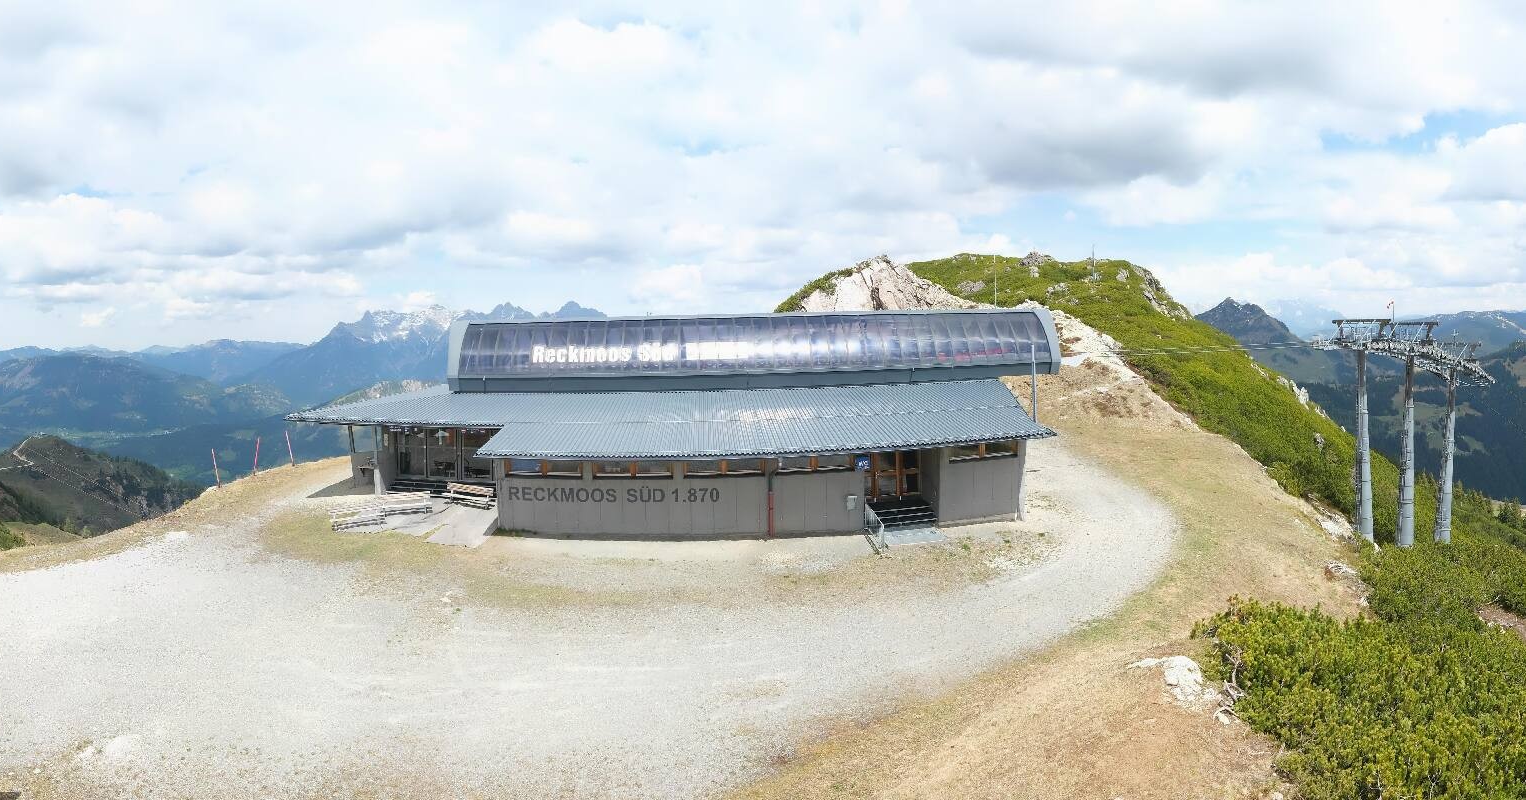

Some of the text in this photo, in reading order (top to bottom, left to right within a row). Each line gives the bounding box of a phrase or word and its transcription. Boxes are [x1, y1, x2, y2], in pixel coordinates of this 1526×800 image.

[532, 344, 633, 363] Reckmoos
[508, 486, 720, 503] RECKMOOS SÜD 1.870
